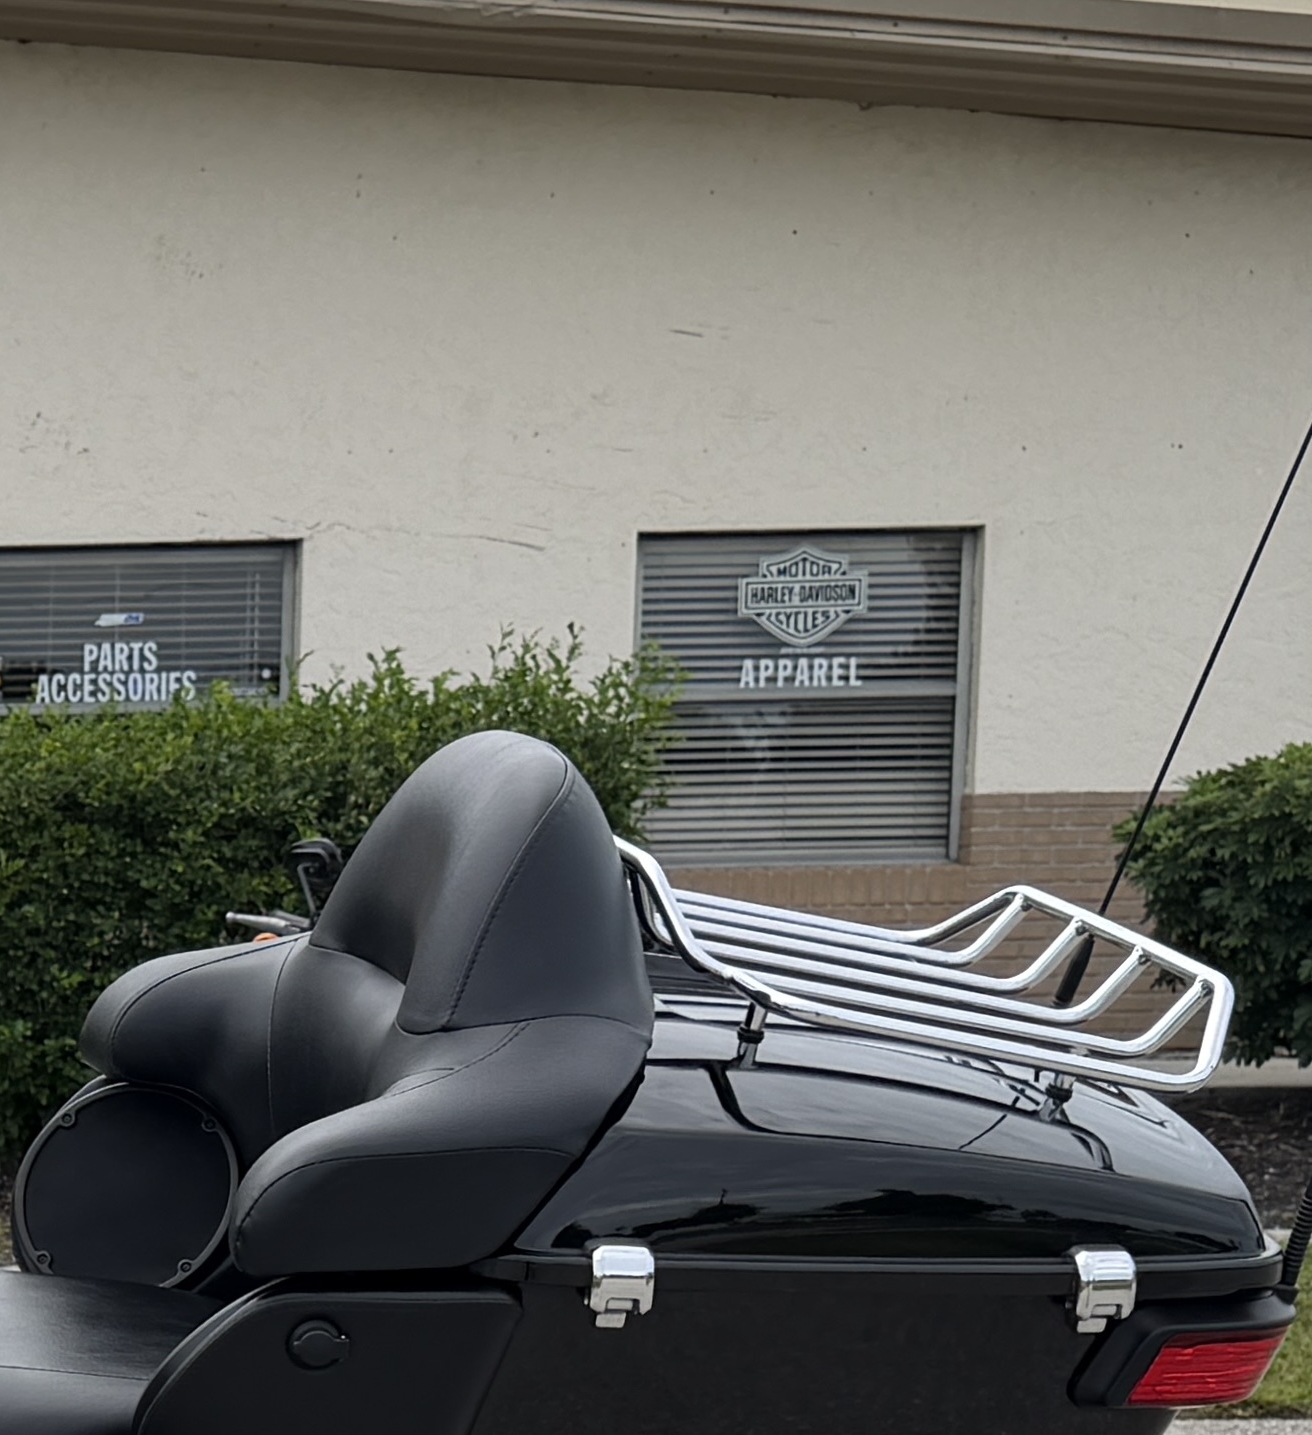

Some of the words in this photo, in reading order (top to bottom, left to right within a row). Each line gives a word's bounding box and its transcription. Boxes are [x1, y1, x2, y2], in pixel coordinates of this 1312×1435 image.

[776, 556, 833, 578] MOTOR
[774, 609, 832, 634] CYCLES
[83, 641, 158, 672] PARTS
[739, 656, 863, 688] APPAREL
